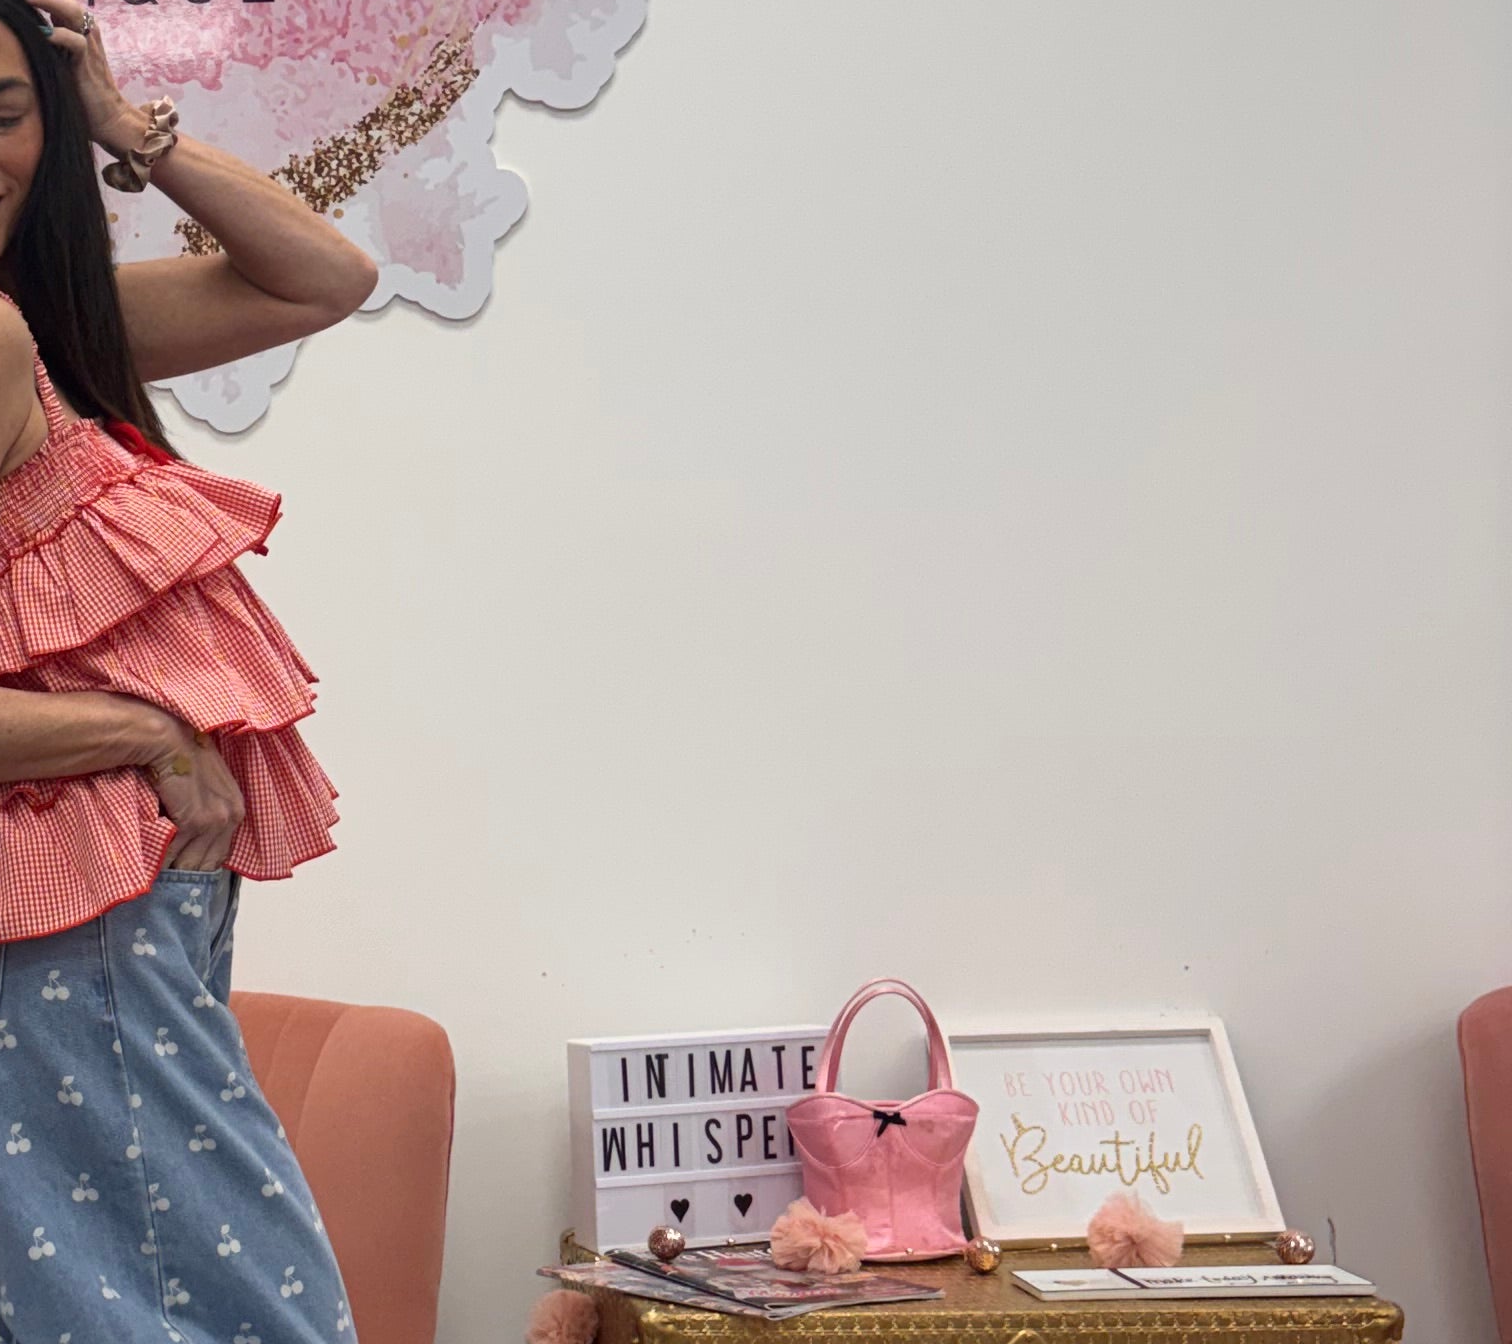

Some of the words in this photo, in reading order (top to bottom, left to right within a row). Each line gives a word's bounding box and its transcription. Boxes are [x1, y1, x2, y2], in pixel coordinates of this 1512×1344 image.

[1004, 1072, 1032, 1097] BE
[1043, 1070, 1110, 1096] YOUR
[1119, 1068, 1175, 1095] OWN
[1057, 1099, 1115, 1126] KIND
[1129, 1099, 1159, 1125] OF
[1000, 1112, 1205, 1195] Beautiful
